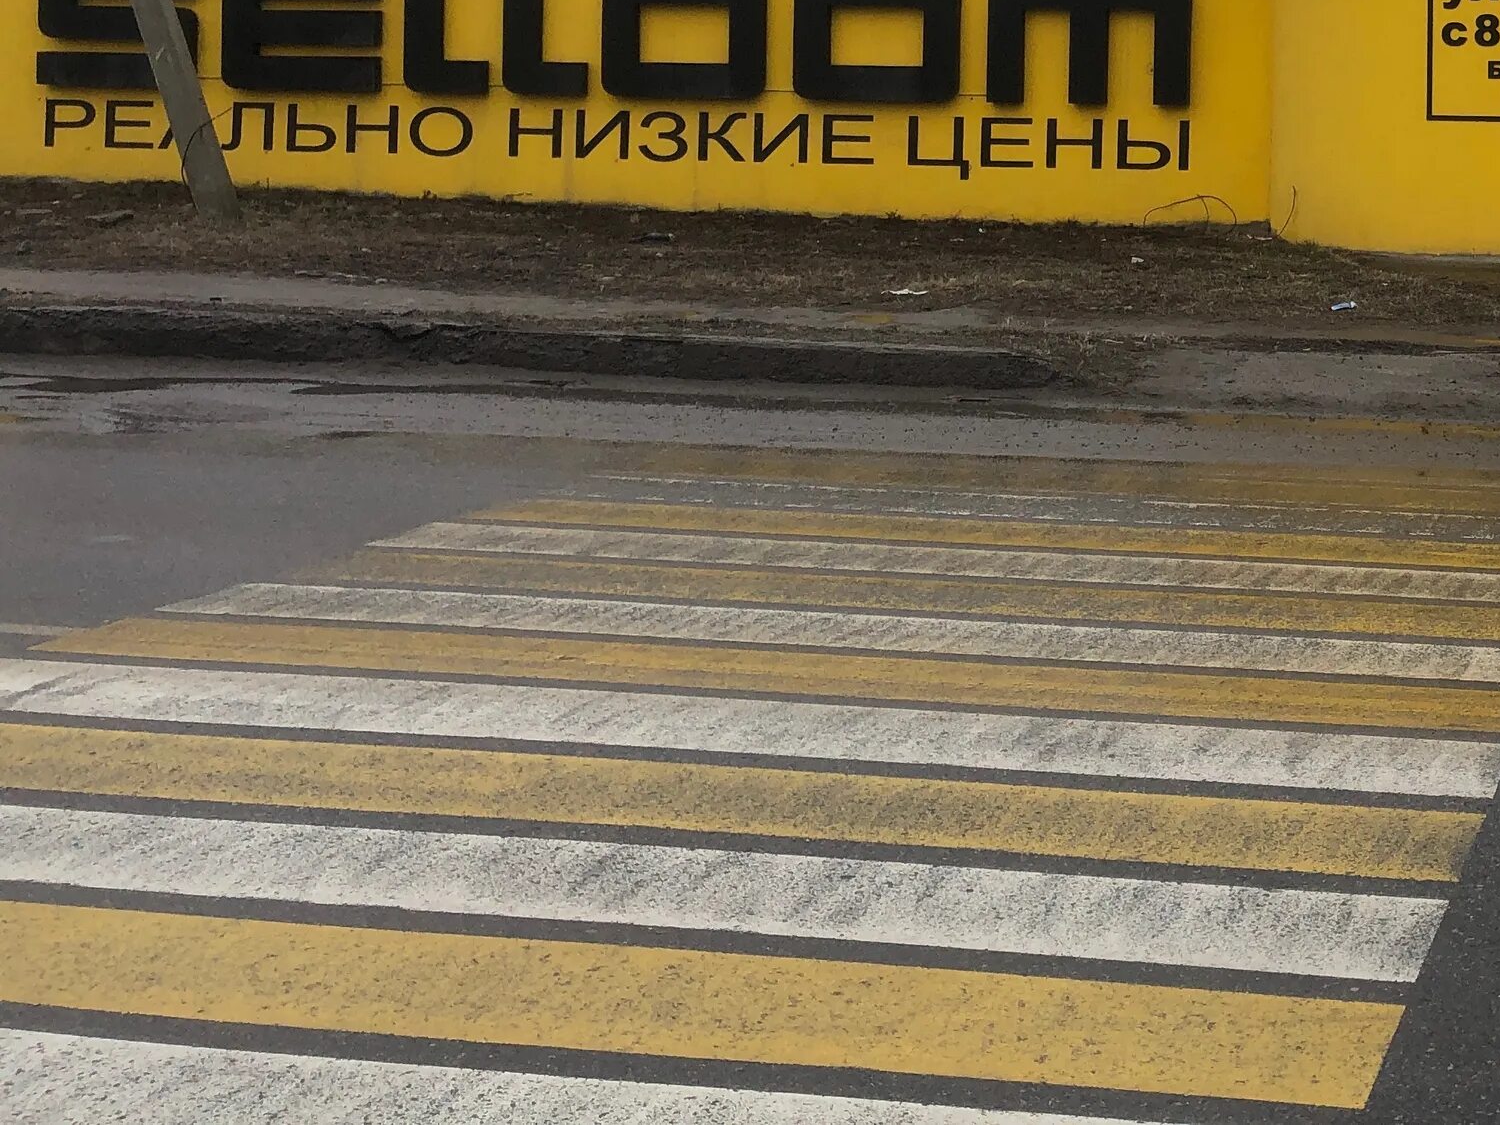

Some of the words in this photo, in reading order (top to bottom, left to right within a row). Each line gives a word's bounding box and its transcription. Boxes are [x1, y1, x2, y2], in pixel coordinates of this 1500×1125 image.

[43, 98, 473, 157] РЕЛЬНО
[508, 108, 875, 165] НИЗКИЕ
[907, 115, 1190, 180] ЦЕНЫ
